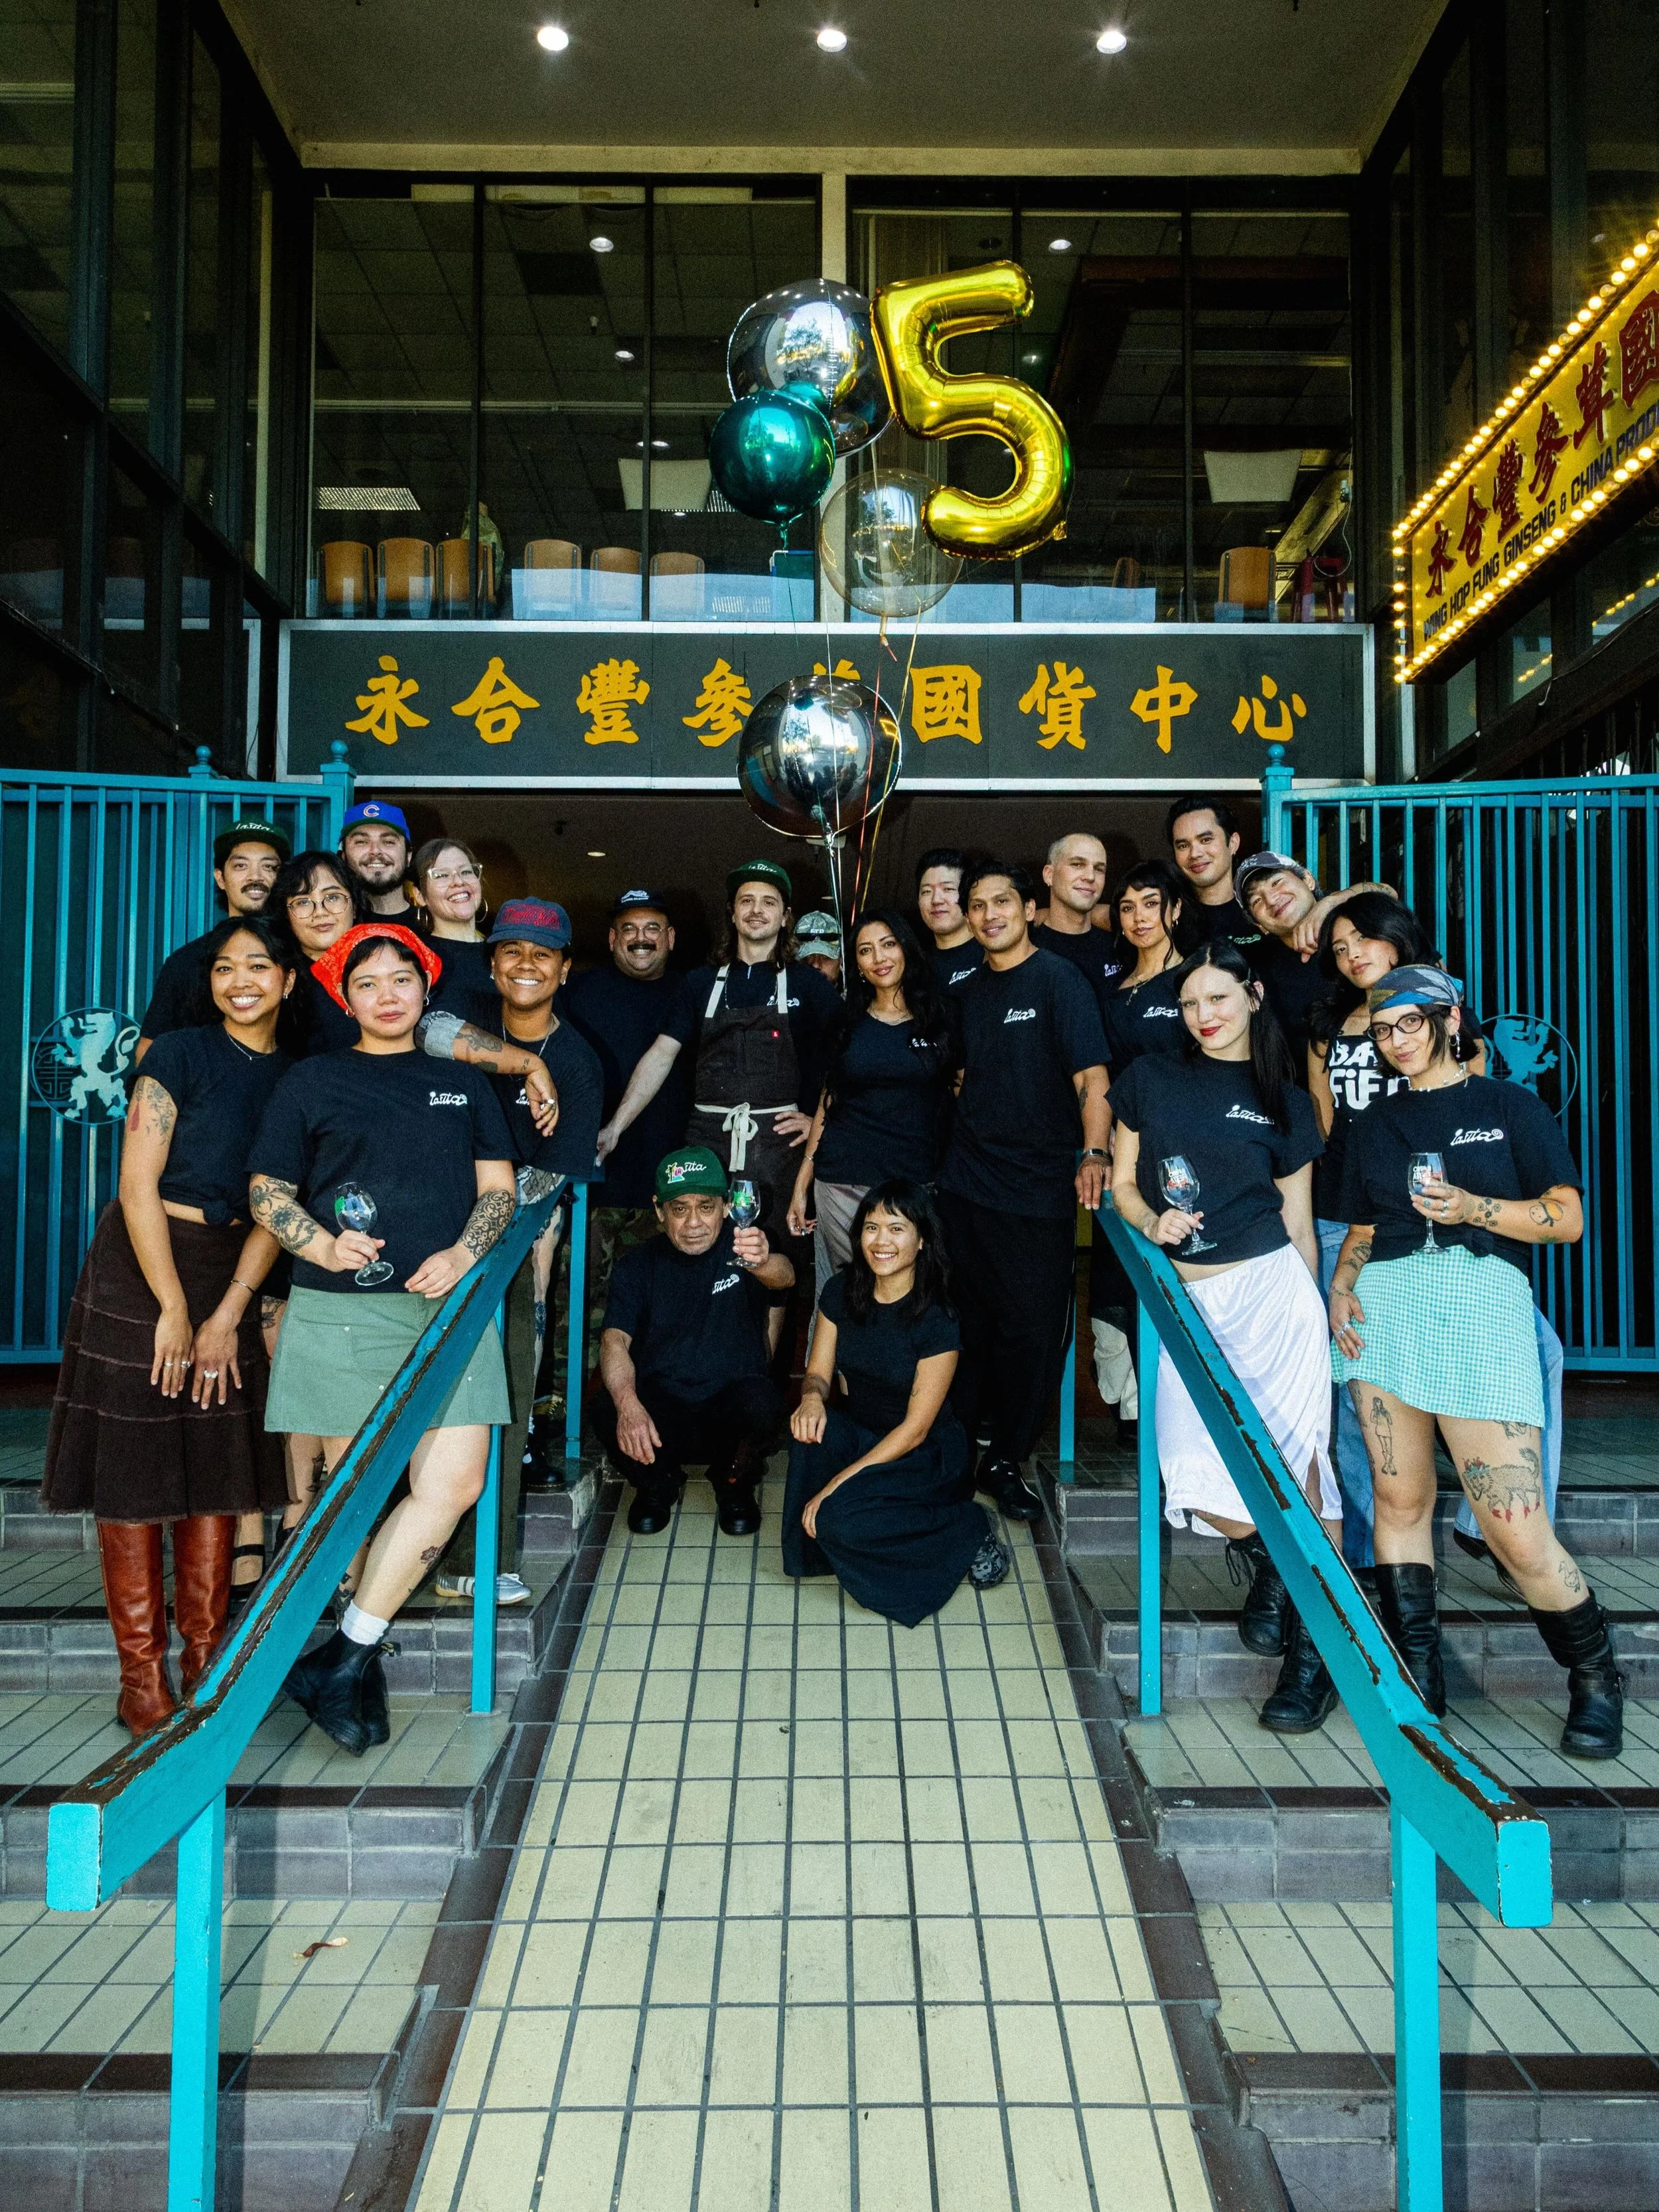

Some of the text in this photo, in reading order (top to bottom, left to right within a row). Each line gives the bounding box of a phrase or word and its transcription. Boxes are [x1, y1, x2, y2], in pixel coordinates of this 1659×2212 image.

[869, 259, 1074, 561] 5
[1423, 602, 1448, 642] WING
[1450, 580, 1471, 619] HOP
[1473, 552, 1500, 598] FUNG
[1504, 499, 1556, 567] GINSENG
[1559, 491, 1567, 515] &
[1571, 445, 1615, 506] CHINA
[344, 654, 1308, 754] 永合豐參國貨中心
[363, 804, 380, 817] C
